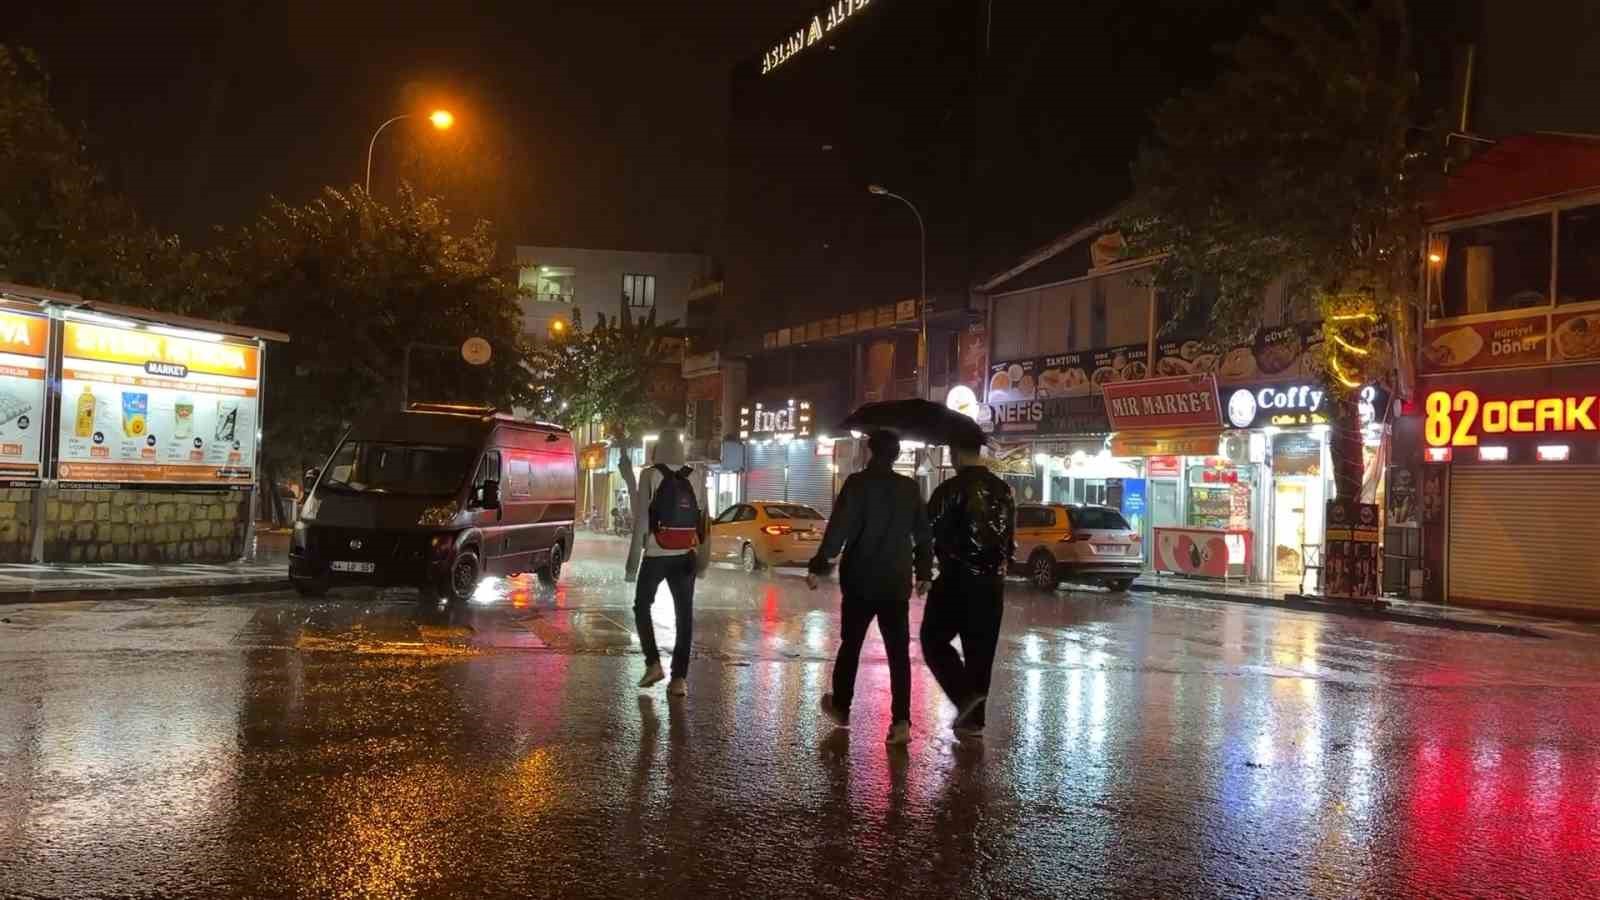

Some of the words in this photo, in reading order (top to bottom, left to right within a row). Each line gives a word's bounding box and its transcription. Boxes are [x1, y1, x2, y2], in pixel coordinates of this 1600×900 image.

[762, 28, 804, 74] ASLAN
[149, 362, 185, 377] MARKET
[1142, 391, 1212, 416] MARKET
[1257, 385, 1323, 412] Coffy
[1425, 390, 1479, 447] 82
[1482, 396, 1597, 432] OCAK
